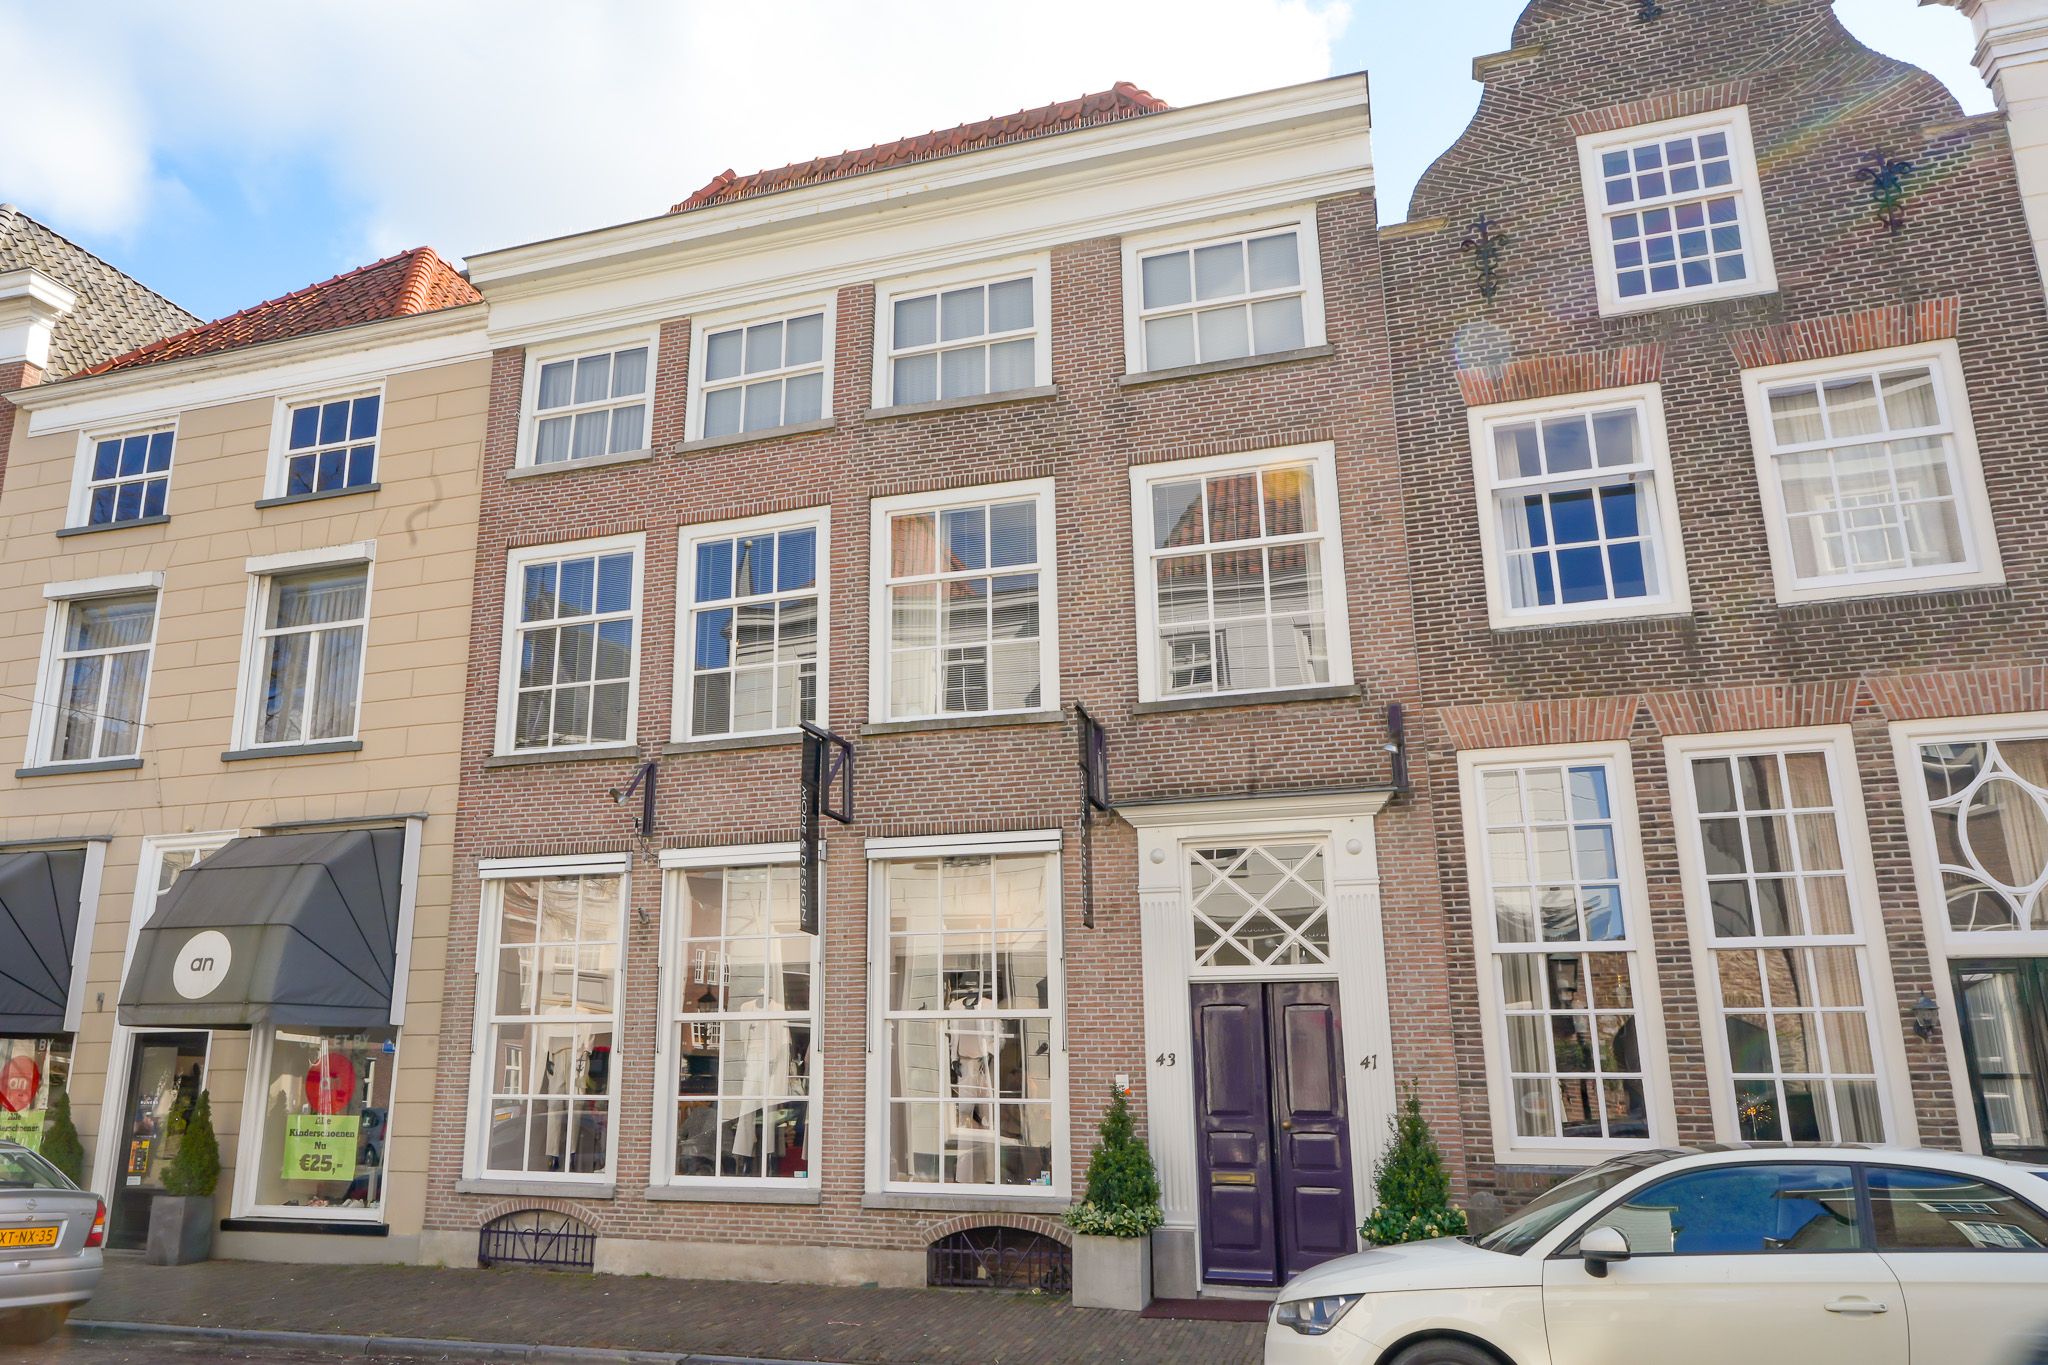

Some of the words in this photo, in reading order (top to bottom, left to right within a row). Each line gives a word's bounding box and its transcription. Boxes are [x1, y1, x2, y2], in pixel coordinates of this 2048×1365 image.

[800, 785, 808, 836] MODE
[800, 839, 808, 850] &
[800, 854, 808, 922] DESIGN
[191, 957, 215, 972] an
[353, 1034, 370, 1048] BY
[1156, 1052, 1176, 1067] 43
[1360, 1054, 1377, 1070] 41
[8, 1077, 28, 1090] an
[314, 1141, 327, 1150] Nu
[299, 1153, 343, 1175] €25,-
